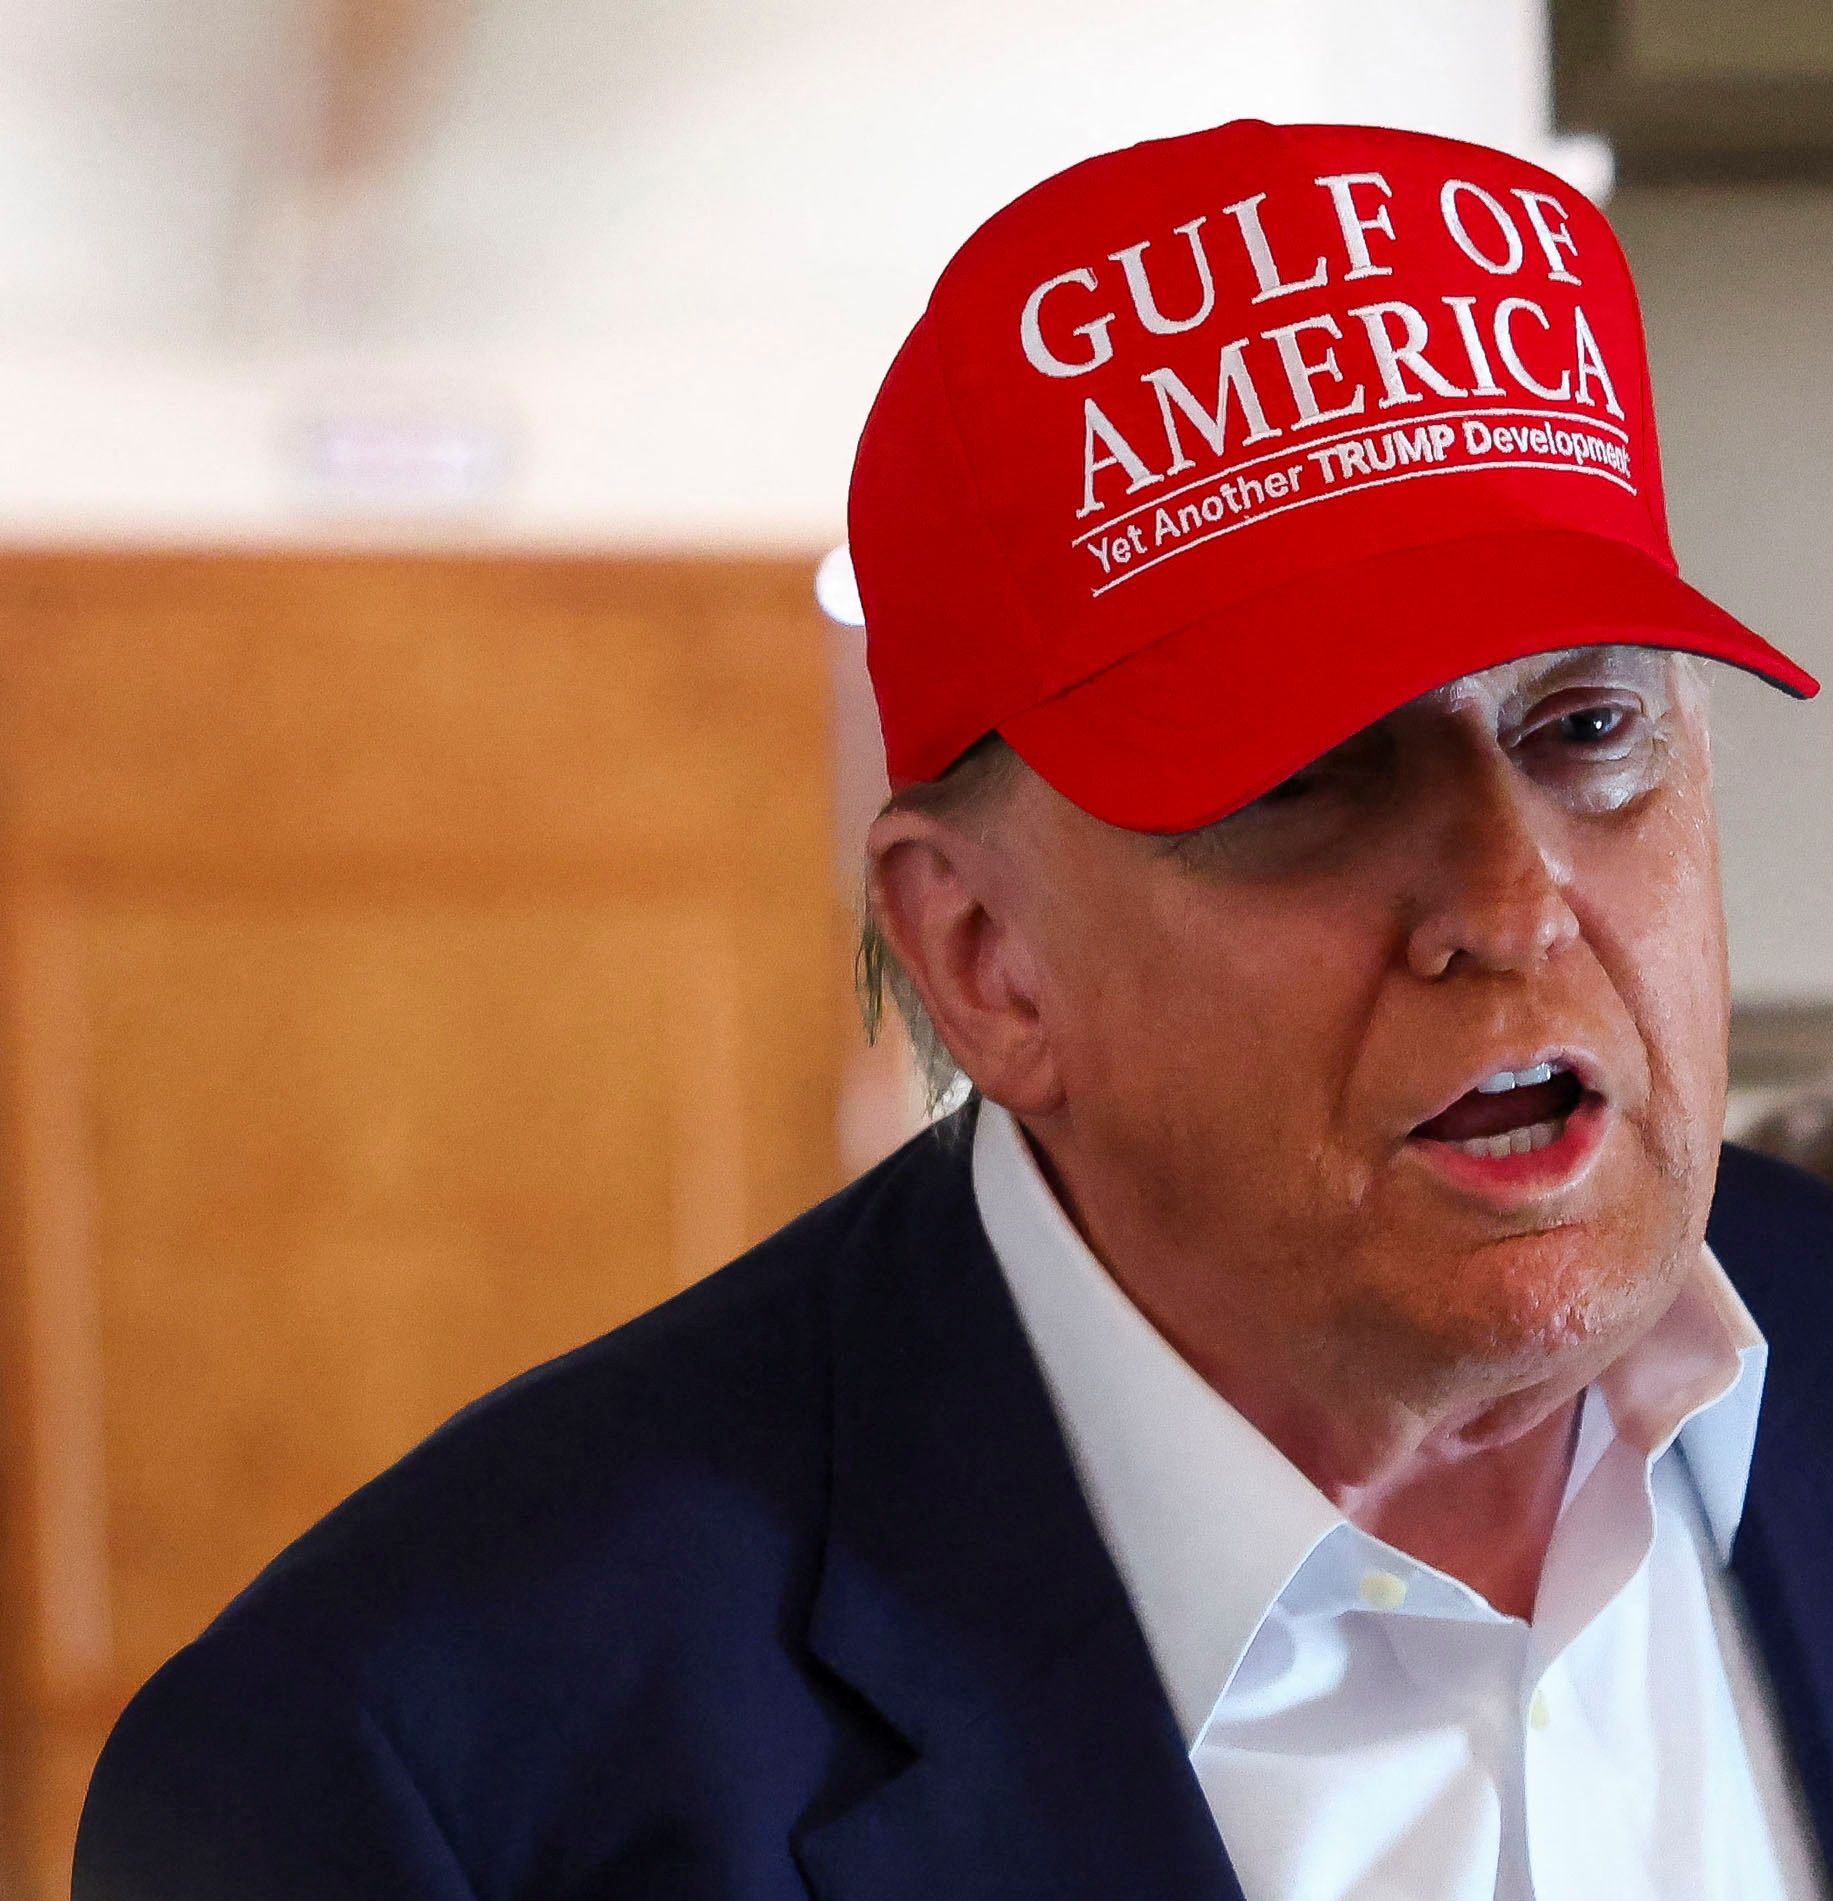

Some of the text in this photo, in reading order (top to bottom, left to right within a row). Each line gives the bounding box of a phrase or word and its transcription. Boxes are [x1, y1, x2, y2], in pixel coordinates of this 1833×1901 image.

[1020, 171, 1582, 378] GULF OF
[1076, 295, 1626, 519] AMERICA
[1087, 419, 1632, 574] Yet Another TRUMP Development
